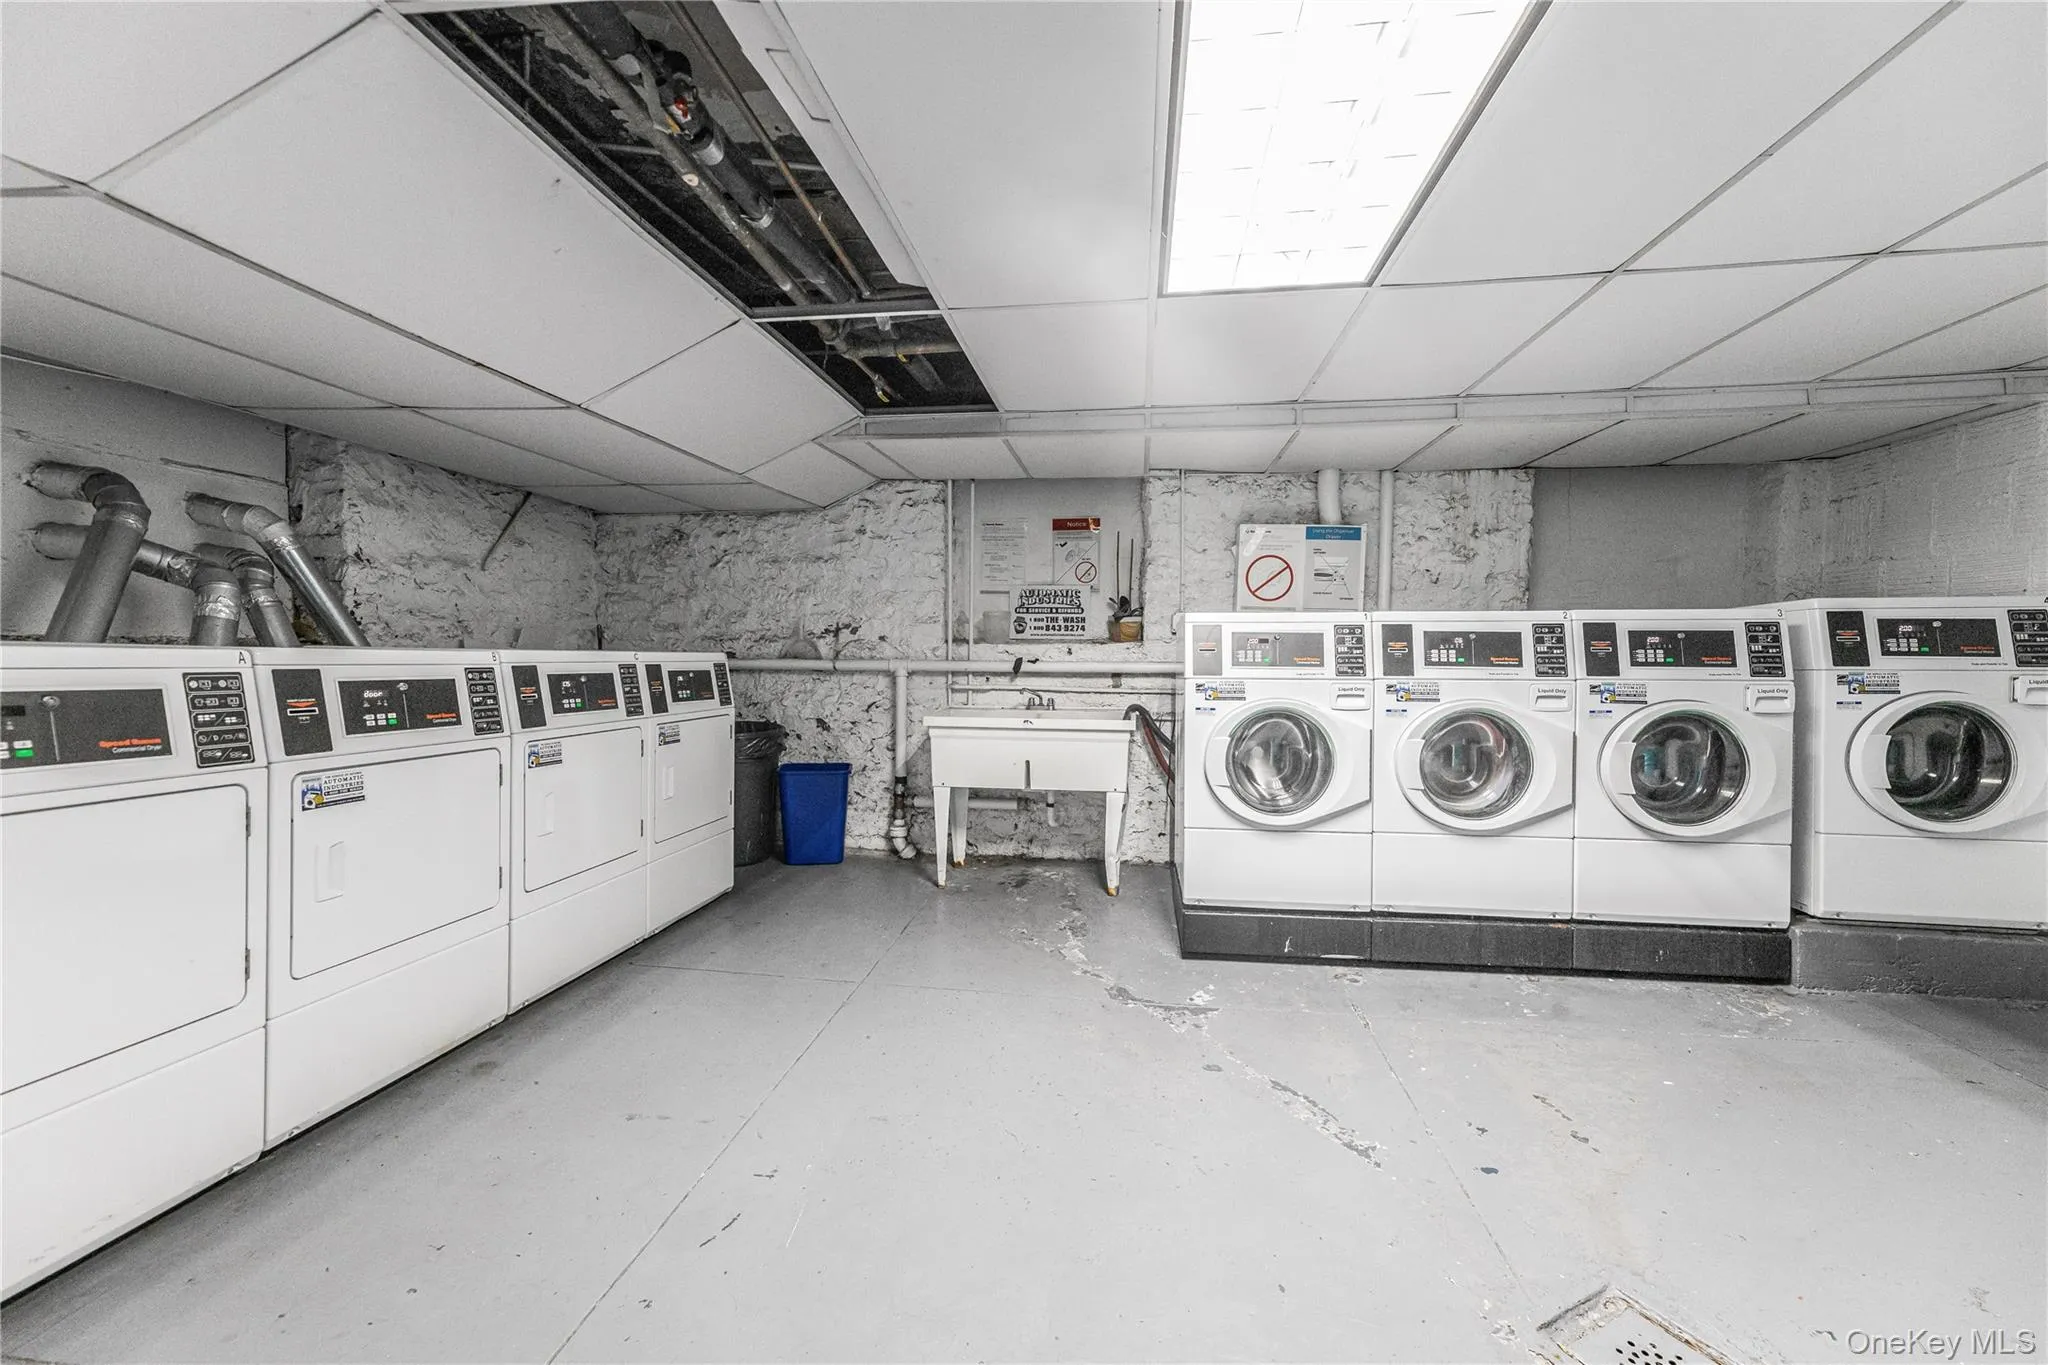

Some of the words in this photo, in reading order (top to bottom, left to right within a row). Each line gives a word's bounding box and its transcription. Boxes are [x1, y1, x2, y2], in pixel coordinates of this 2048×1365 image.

[1019, 589, 1081, 598] AUTOMATIC
[1018, 596, 1082, 607] INDUSTRIES
[1777, 609, 1783, 618] 3
[238, 652, 247, 664] A
[323, 775, 364, 785] AUTOMATIC
[324, 781, 364, 791] INDUSTRIES
